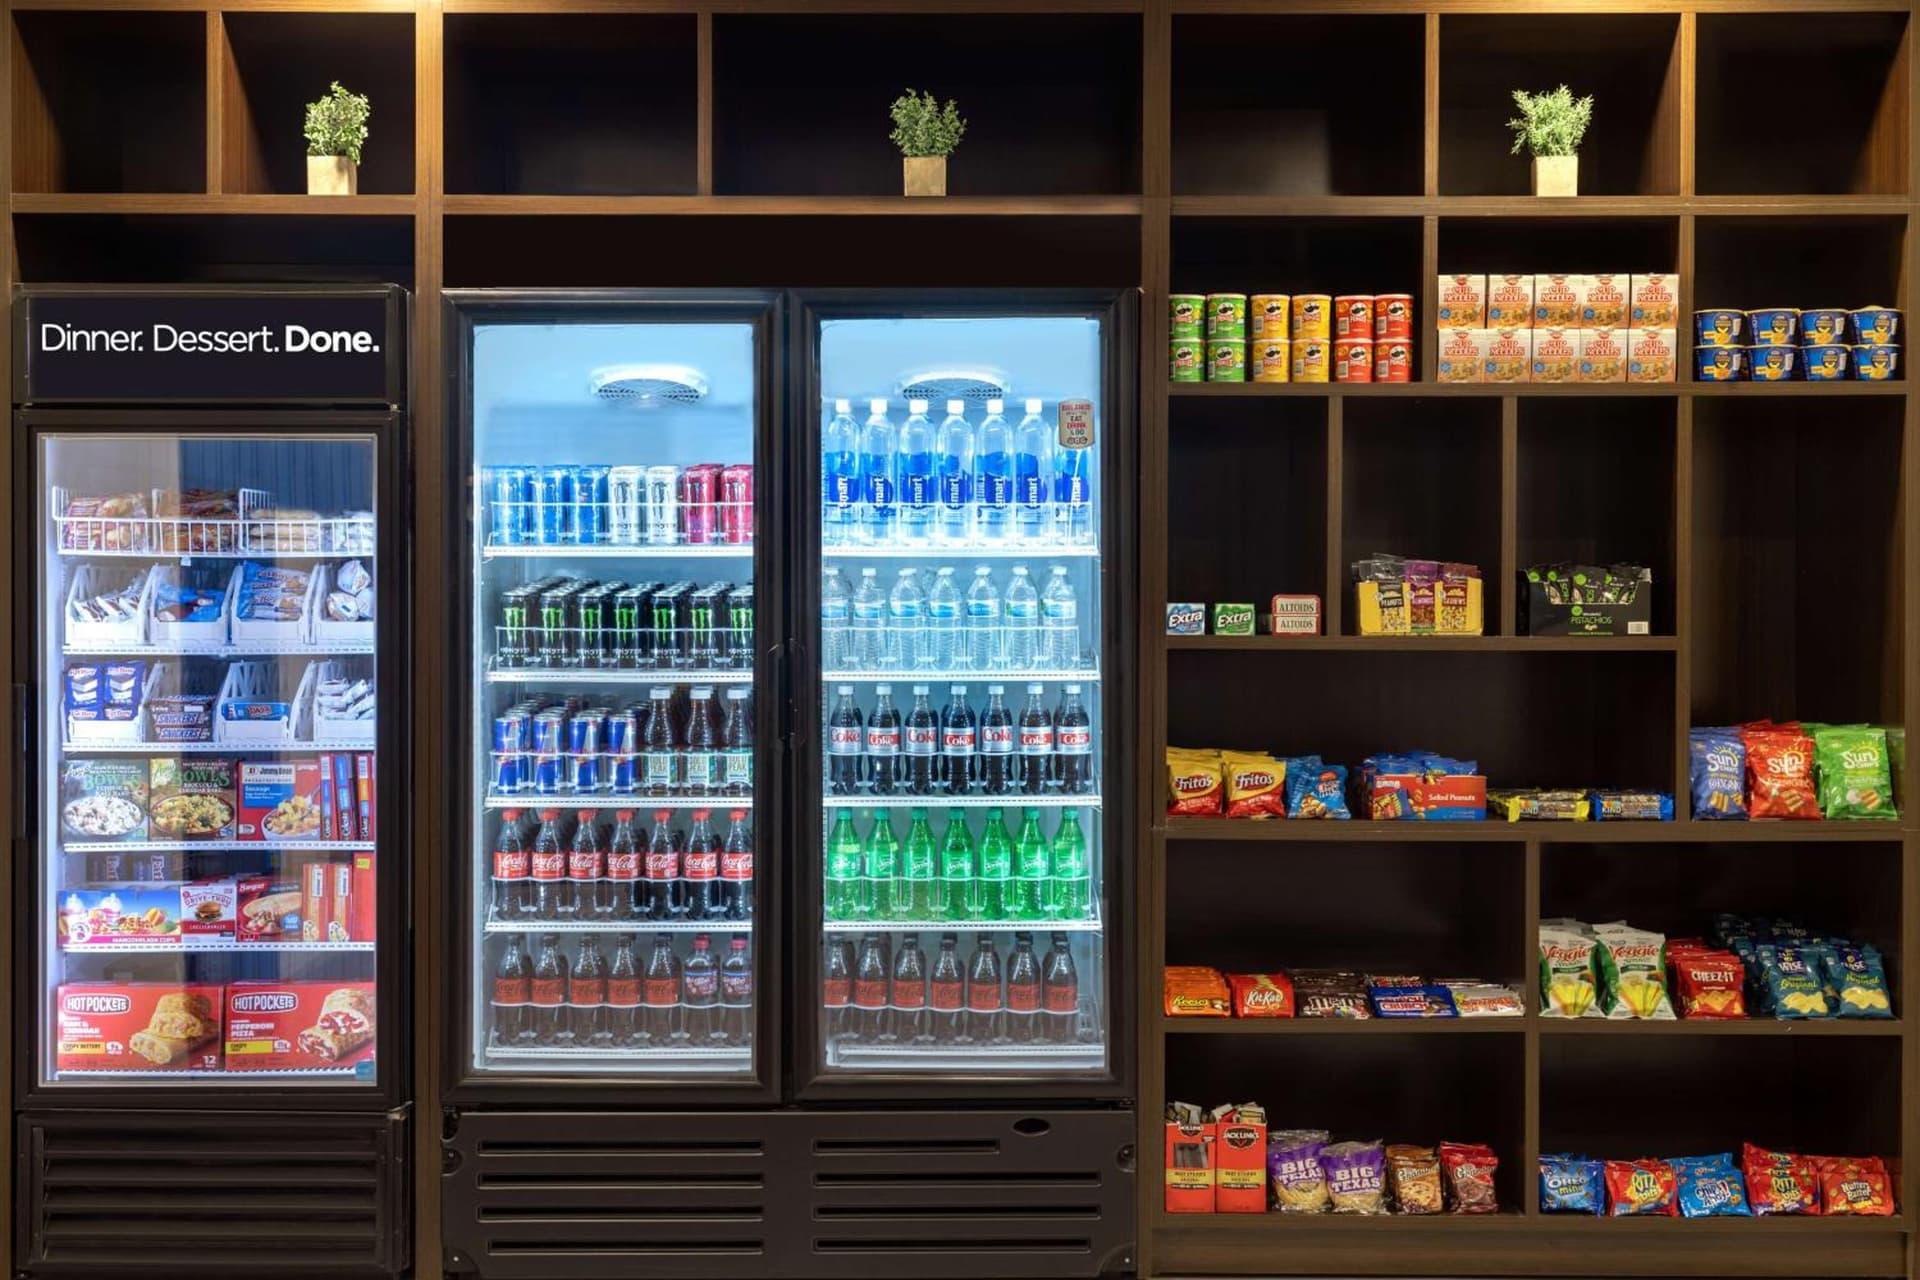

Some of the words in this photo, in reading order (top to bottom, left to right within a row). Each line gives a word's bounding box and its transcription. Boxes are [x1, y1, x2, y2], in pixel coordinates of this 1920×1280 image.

[41, 323, 144, 352] Dinner.
[153, 325, 279, 352] Dessert.
[285, 325, 380, 352] Done.
[1279, 603, 1314, 613] ALTOIDS
[1168, 611, 1203, 627] Extra
[1217, 611, 1252, 628] Extra
[1280, 619, 1313, 628] ALTOIDS
[946, 736, 970, 746] Coke
[1063, 734, 1087, 745] Coke
[1706, 753, 1738, 771] Sun
[1767, 753, 1804, 774] Sun
[1842, 750, 1879, 768] Sun
[1177, 774, 1213, 790] Fritos
[1237, 773, 1273, 790] Fritos
[1543, 946, 1589, 961] Veggie
[1609, 945, 1659, 960] Veggie
[1779, 961, 1804, 972] WISE
[1691, 971, 1735, 982] CHEEZ-IT
[1381, 1002, 1429, 1010] CRUNCH
[203, 1056, 217, 1064] 12
[1281, 1158, 1317, 1174] BIG
[1335, 1166, 1374, 1181] BIG
[1332, 1177, 1381, 1192] TEXAS
[1548, 1177, 1587, 1189] OREO
[1632, 1172, 1656, 1193] RITZ
[1772, 1177, 1798, 1193] RITZ
[1841, 1182, 1869, 1192] Nutter
[1848, 1190, 1871, 1200] Butter
